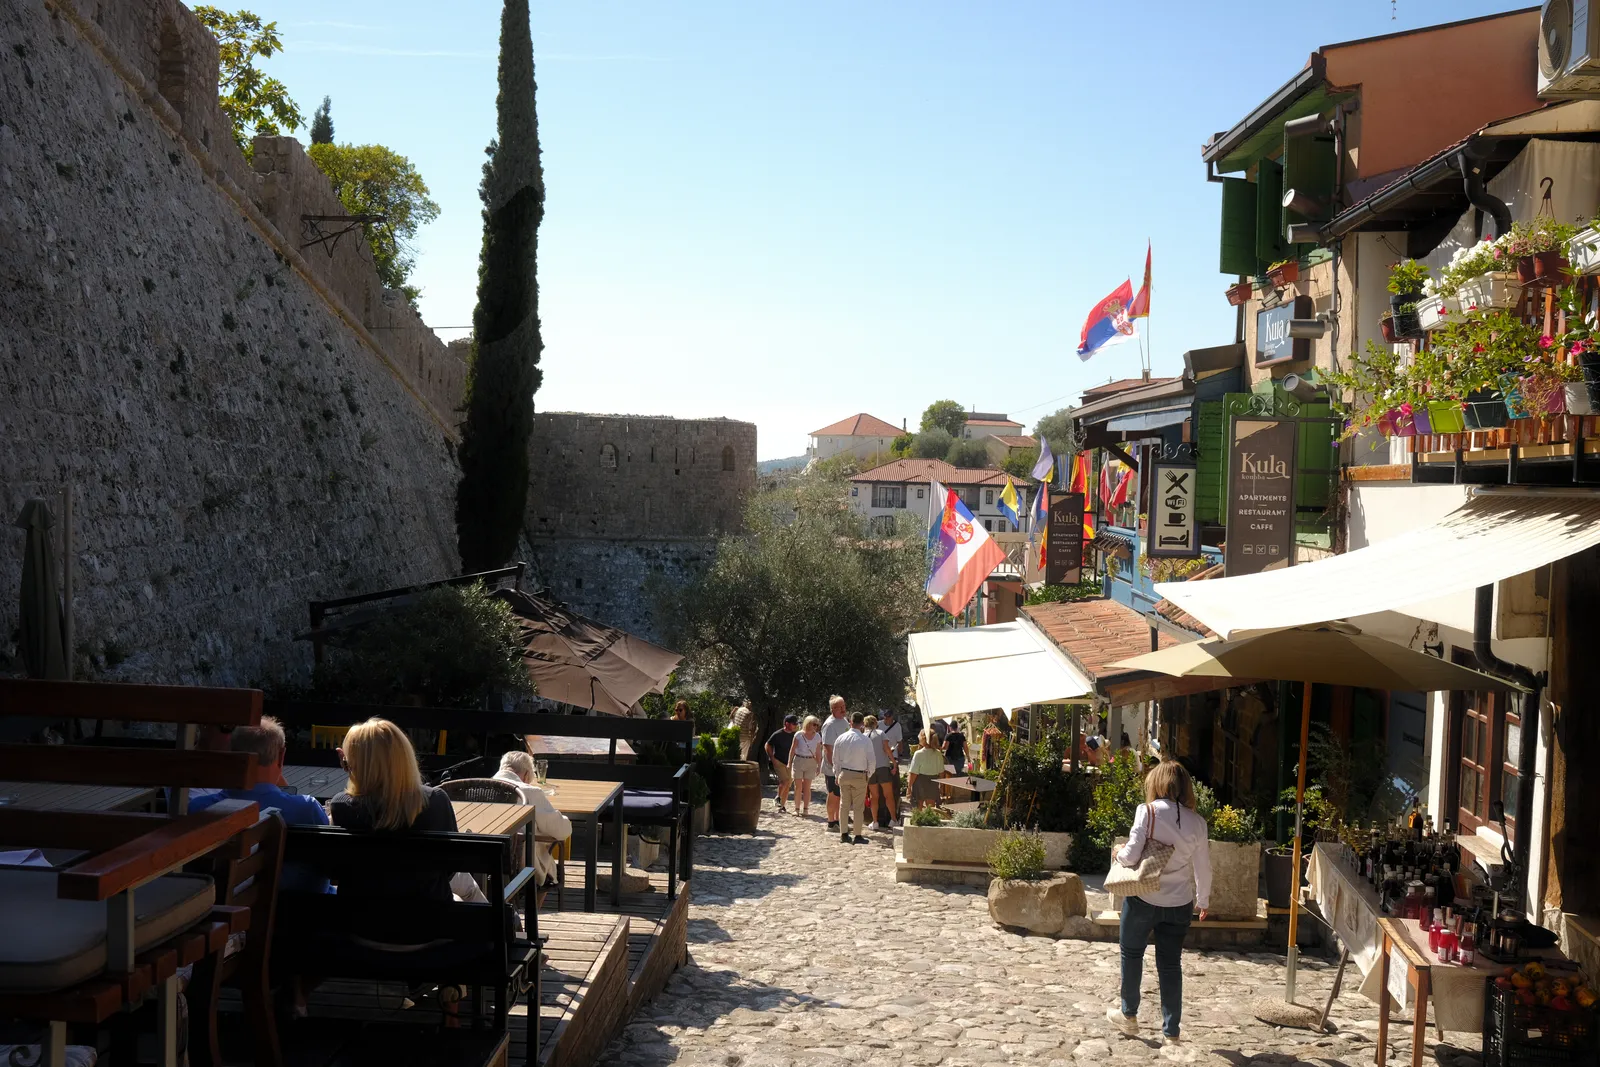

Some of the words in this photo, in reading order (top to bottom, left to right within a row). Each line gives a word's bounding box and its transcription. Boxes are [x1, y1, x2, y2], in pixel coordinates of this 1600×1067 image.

[1265, 312, 1285, 348] Kula
[1241, 452, 1290, 479] Kula
[1239, 494, 1287, 502] APARTMENTS
[1053, 510, 1080, 526] Kula
[1238, 508, 1286, 516] RESTAURANT
[1250, 523, 1274, 531] CAFFE
